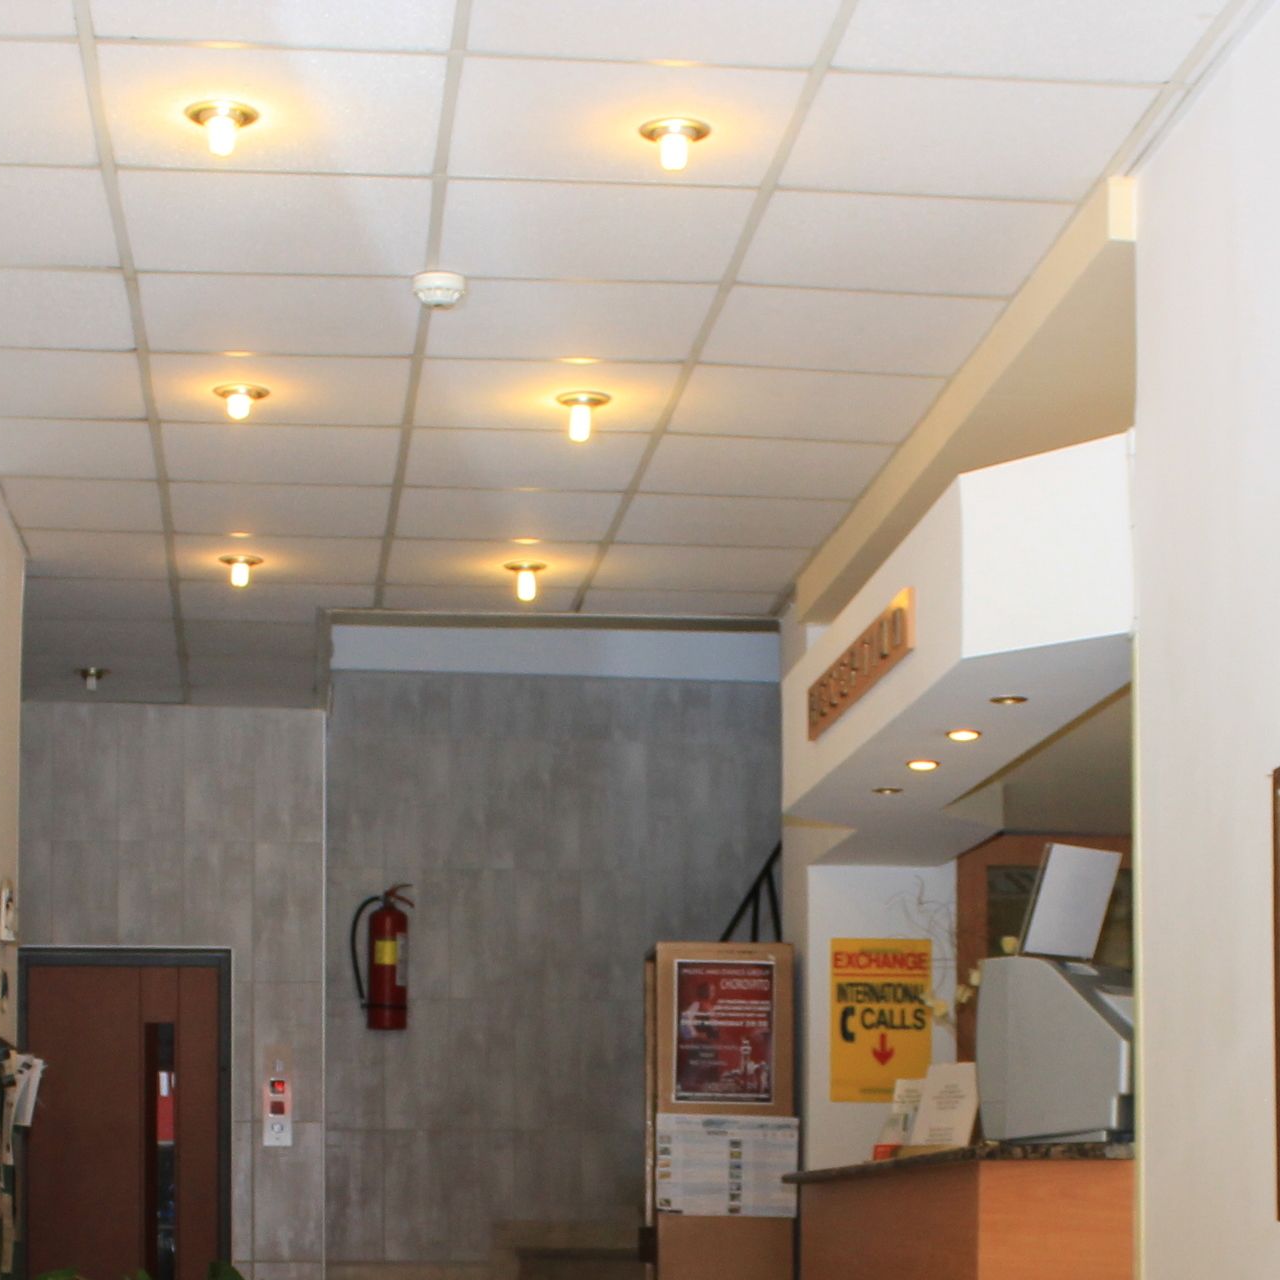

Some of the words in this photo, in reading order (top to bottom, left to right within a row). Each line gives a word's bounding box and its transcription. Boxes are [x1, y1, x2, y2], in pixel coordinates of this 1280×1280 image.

[833, 952, 929, 971] EXCHANGE
[837, 983, 926, 1004] INTERNATIONAL
[861, 1008, 926, 1030] CALLS
